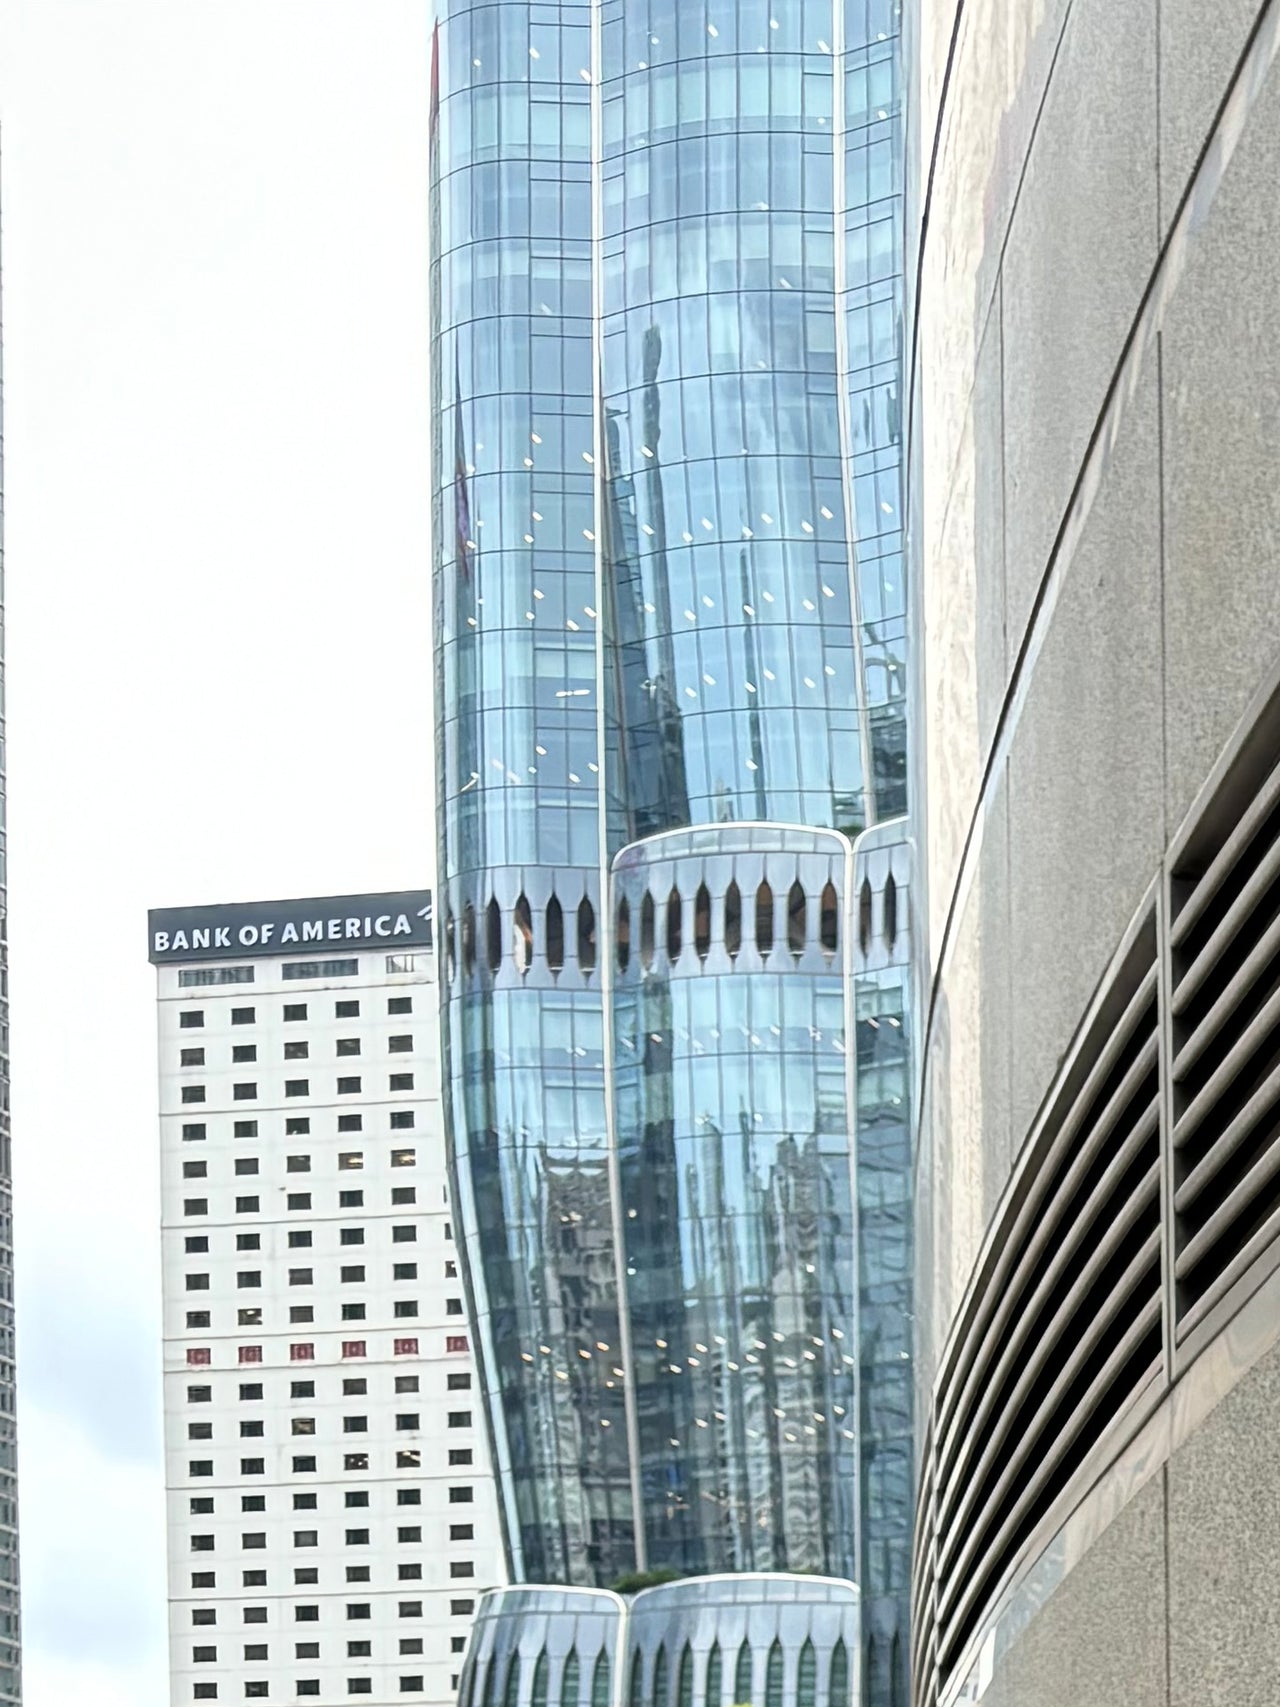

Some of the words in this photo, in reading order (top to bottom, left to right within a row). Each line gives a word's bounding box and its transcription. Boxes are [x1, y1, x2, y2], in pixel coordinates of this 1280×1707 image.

[154, 926, 231, 951] BANK
[238, 923, 275, 946] OF
[281, 914, 412, 943] AMERICA
